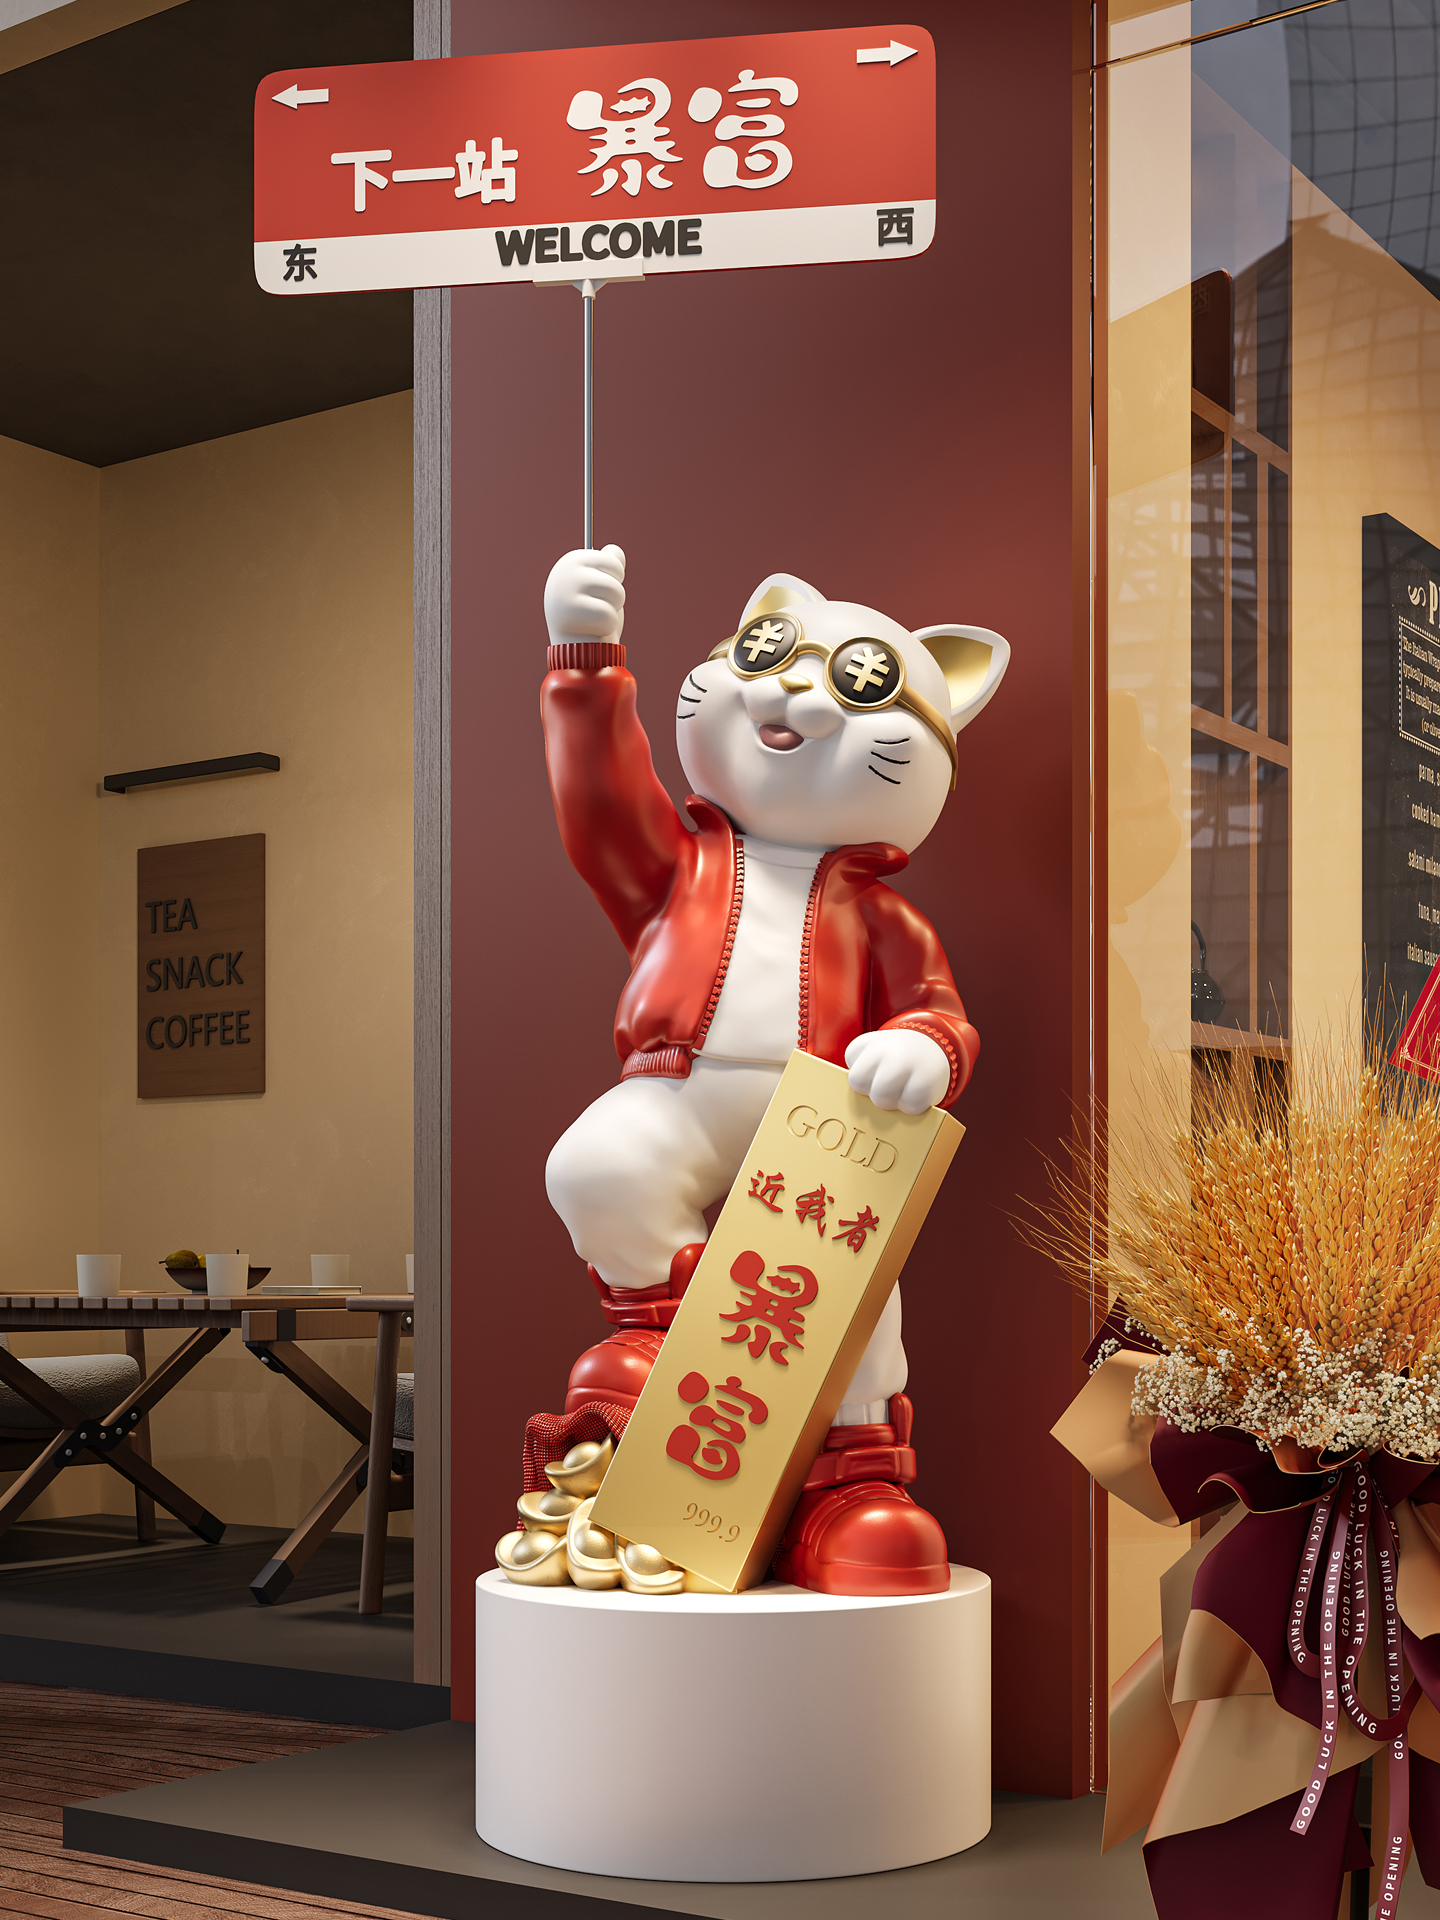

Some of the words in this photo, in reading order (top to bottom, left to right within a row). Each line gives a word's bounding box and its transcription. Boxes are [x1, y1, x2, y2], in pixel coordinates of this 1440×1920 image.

[331, 137, 518, 212] 下一站
[567, 69, 799, 197] 暴富
[495, 218, 702, 267] WELCOME
[876, 207, 915, 246] 西
[283, 243, 318, 282] 东
[145, 898, 198, 933] TEA
[145, 951, 244, 992] SNACK
[145, 1010, 251, 1050] COFFEE
[785, 1103, 900, 1175] GOLD
[747, 1169, 881, 1254] 近我者
[665, 1250, 819, 1481] 暴富
[1354, 1461, 1368, 1513] GOOD
[682, 1502, 742, 1544] 999.9
[1311, 1508, 1327, 1542] LUCK
[1305, 1547, 1316, 1561] IN
[1354, 1523, 1365, 1571] LUCK
[1298, 1568, 1311, 1593] THE
[1323, 1551, 1341, 1632] OPENING
[1355, 1580, 1365, 1600] IN
[1380, 1550, 1395, 1611] OPENING
[1291, 1600, 1306, 1663] OPENING
[1341, 1596, 1351, 1637] GOOD
[1353, 1609, 1365, 1645] THE
[1386, 1618, 1397, 1645] THE
[1323, 1642, 1333, 1678] THE
[1388, 1652, 1398, 1666] IN
[1325, 1690, 1335, 1708] IN
[1341, 1655, 1377, 1734] OPENING
[1390, 1673, 1401, 1711] LUCK
[1318, 1720, 1335, 1770] LUCK
[1296, 1779, 1321, 1829] GOOD
[1384, 1836, 1403, 1902] OPENING
